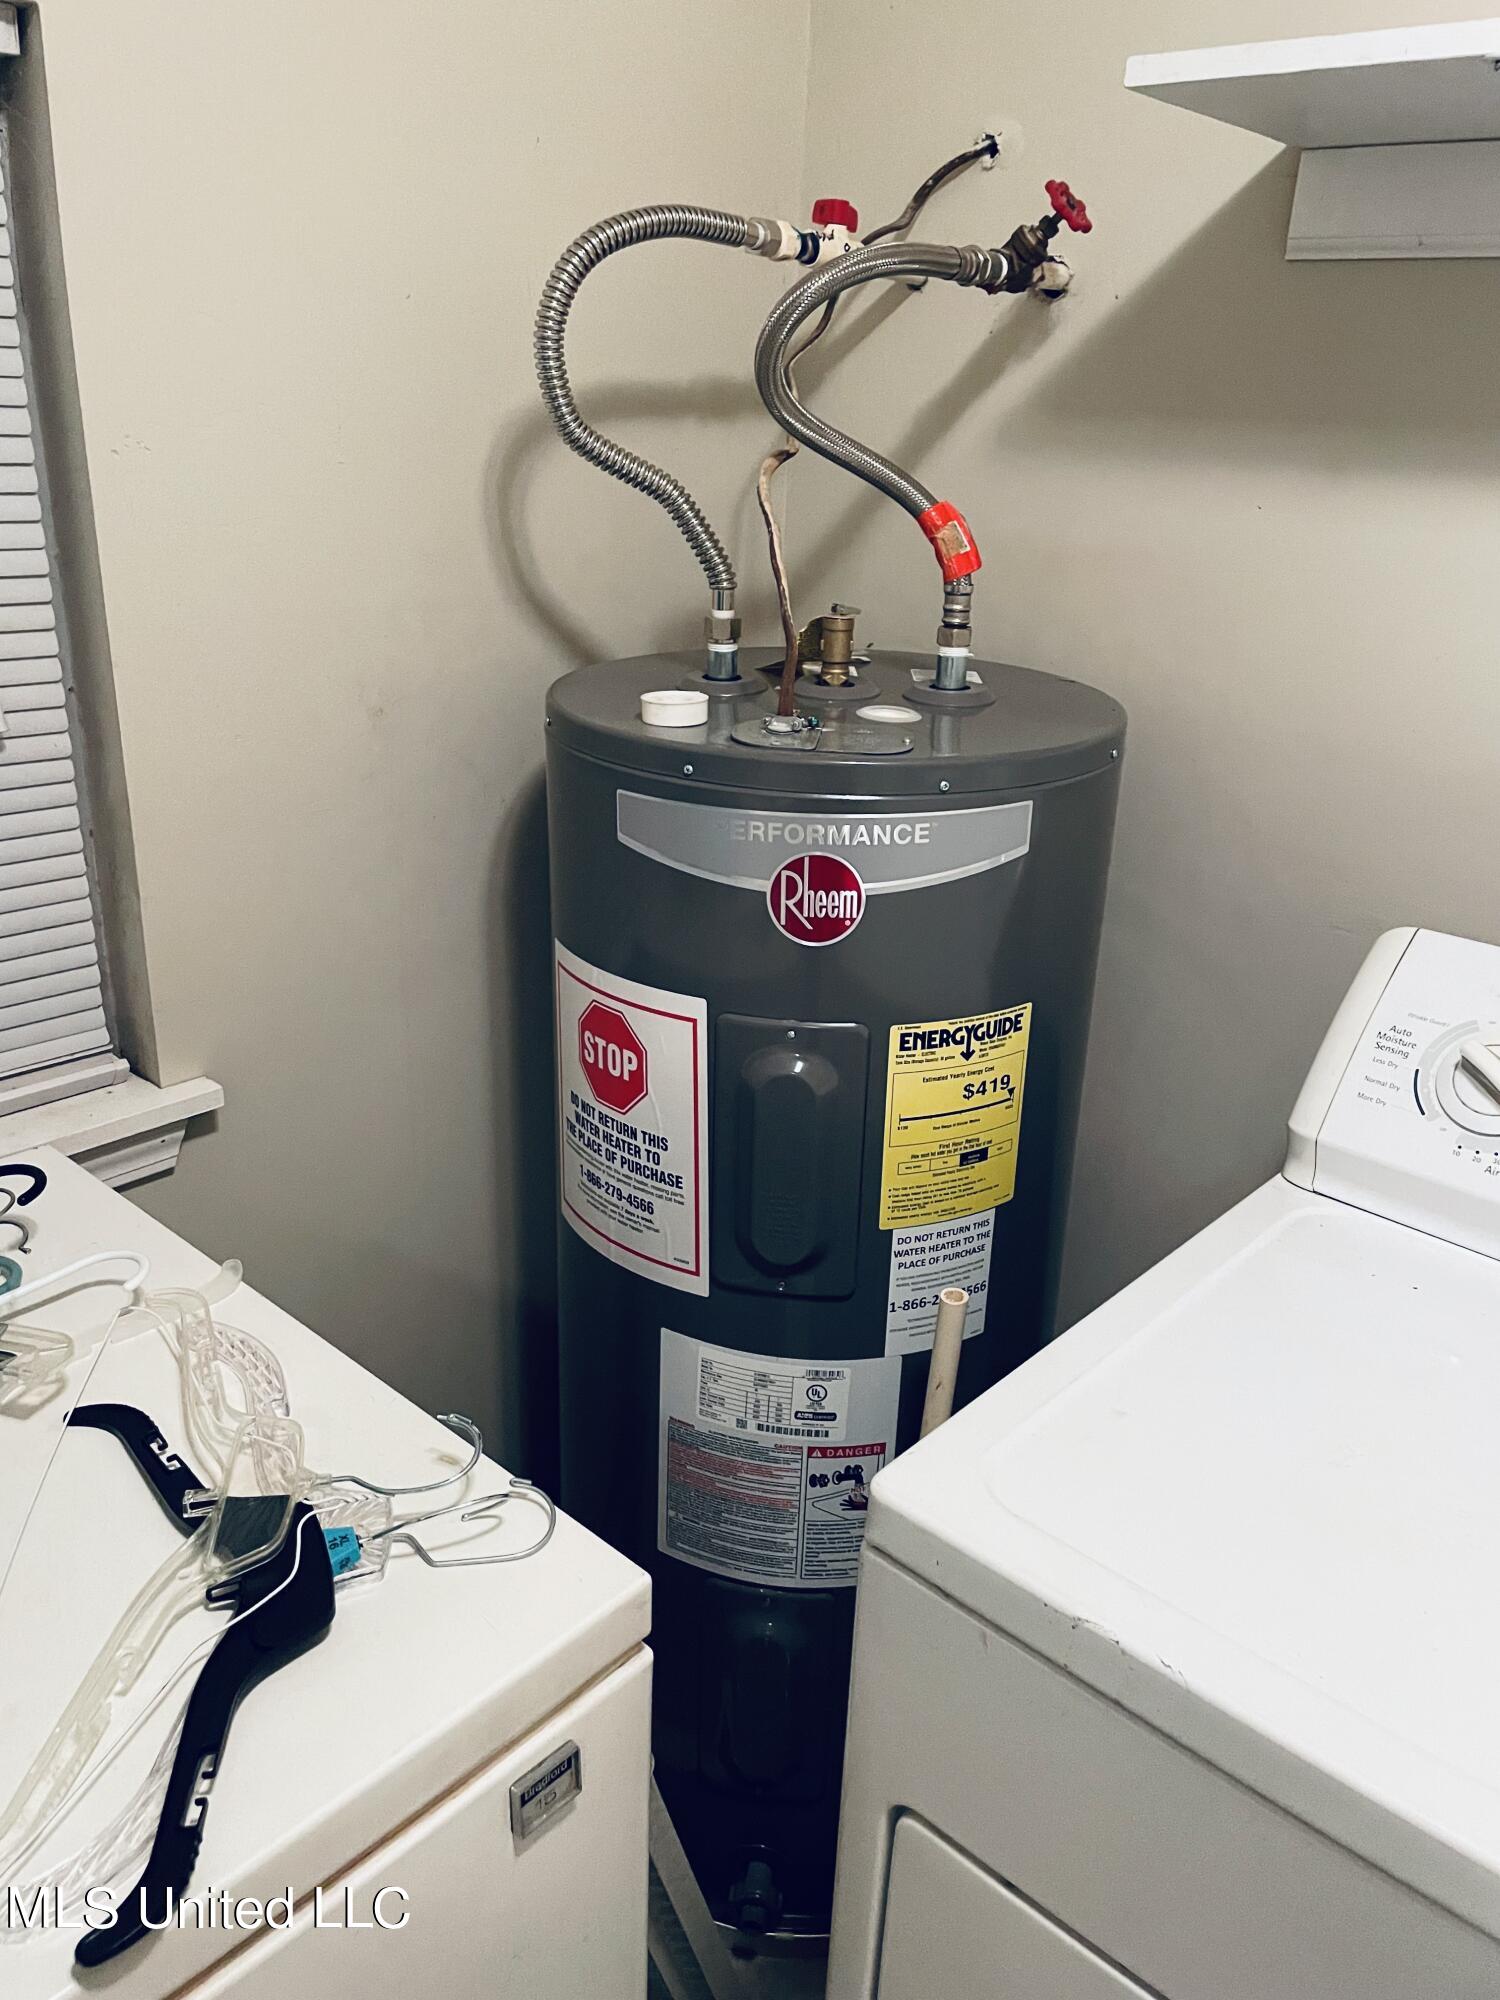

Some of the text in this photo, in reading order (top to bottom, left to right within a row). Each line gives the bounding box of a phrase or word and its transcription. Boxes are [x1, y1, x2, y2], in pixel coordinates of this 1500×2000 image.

[726, 819, 931, 846] ERFORMANCE
[780, 857, 857, 930] Rheem
[899, 1012, 1024, 1052] ENERGYGUIDE
[1376, 1031, 1417, 1049] Moisture
[1389, 1025, 1412, 1037] Auto
[584, 1030, 638, 1081] STOP
[1373, 1057, 1398, 1069] Less Dry
[1374, 1042, 1409, 1059] Sensing
[963, 1074, 1011, 1100] $419
[1365, 1075, 1400, 1091] Normal Dry
[1357, 1092, 1387, 1106] More Dry
[570, 1090, 669, 1151] DO NOT RETURN THIS
[574, 1110, 600, 1137] WATER
[602, 1129, 641, 1159] HEATER
[645, 1150, 661, 1166] TO
[566, 1117, 577, 1138] THE
[579, 1129, 602, 1157] PLACE
[605, 1148, 618, 1164] OF
[620, 1156, 684, 1189] PURCHASE
[1452, 1149, 1461, 1157] 10
[1472, 1155, 1482, 1163] 20
[580, 1164, 655, 1215] 1-866-279-4566
[894, 1230, 991, 1258] WATER HEATER TO THE
[897, 1218, 990, 1245] DO NOT RETURN THIS
[898, 1244, 986, 1270] PLACE OF PURCHASE
[812, 1387, 822, 1399] UL
[826, 1445, 881, 1458] DANGER
[329, 1536, 339, 1550] 16
